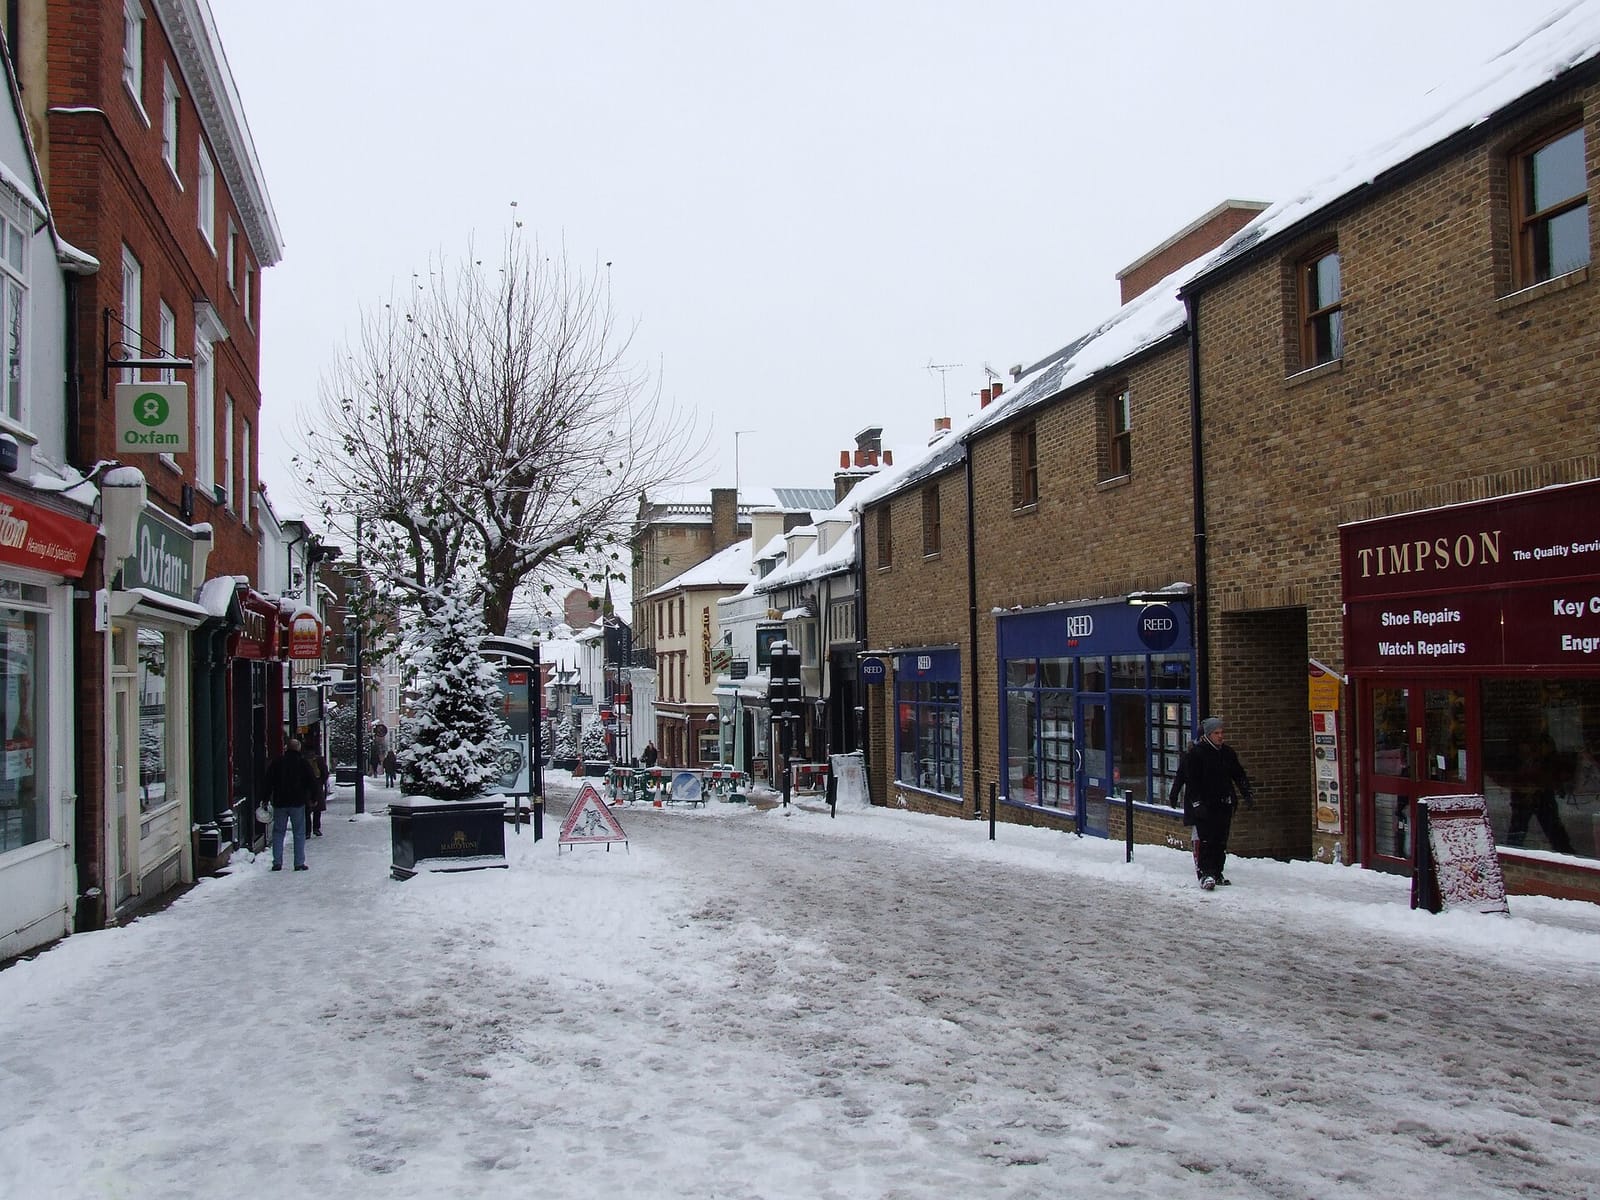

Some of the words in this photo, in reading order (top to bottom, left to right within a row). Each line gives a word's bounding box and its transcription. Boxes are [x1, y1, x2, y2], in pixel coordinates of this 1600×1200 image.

[124, 430, 179, 444] Oxfam
[140, 524, 182, 594] Oxfam
[1357, 530, 1501, 578] TIMPSON
[1513, 550, 1531, 560] The
[1533, 544, 1569, 560] Quality
[1571, 540, 1600, 554] Servi
[1381, 611, 1410, 627] Shoe
[1413, 608, 1461, 626] Repairs
[1553, 599, 1585, 618] Key
[1589, 597, 1600, 613] C
[1067, 615, 1093, 637] REED
[1143, 618, 1173, 631] REED
[1378, 641, 1414, 656] Watch
[1417, 639, 1466, 657] Repairs
[1561, 634, 1600, 654] Engr
[863, 666, 882, 674] REED
